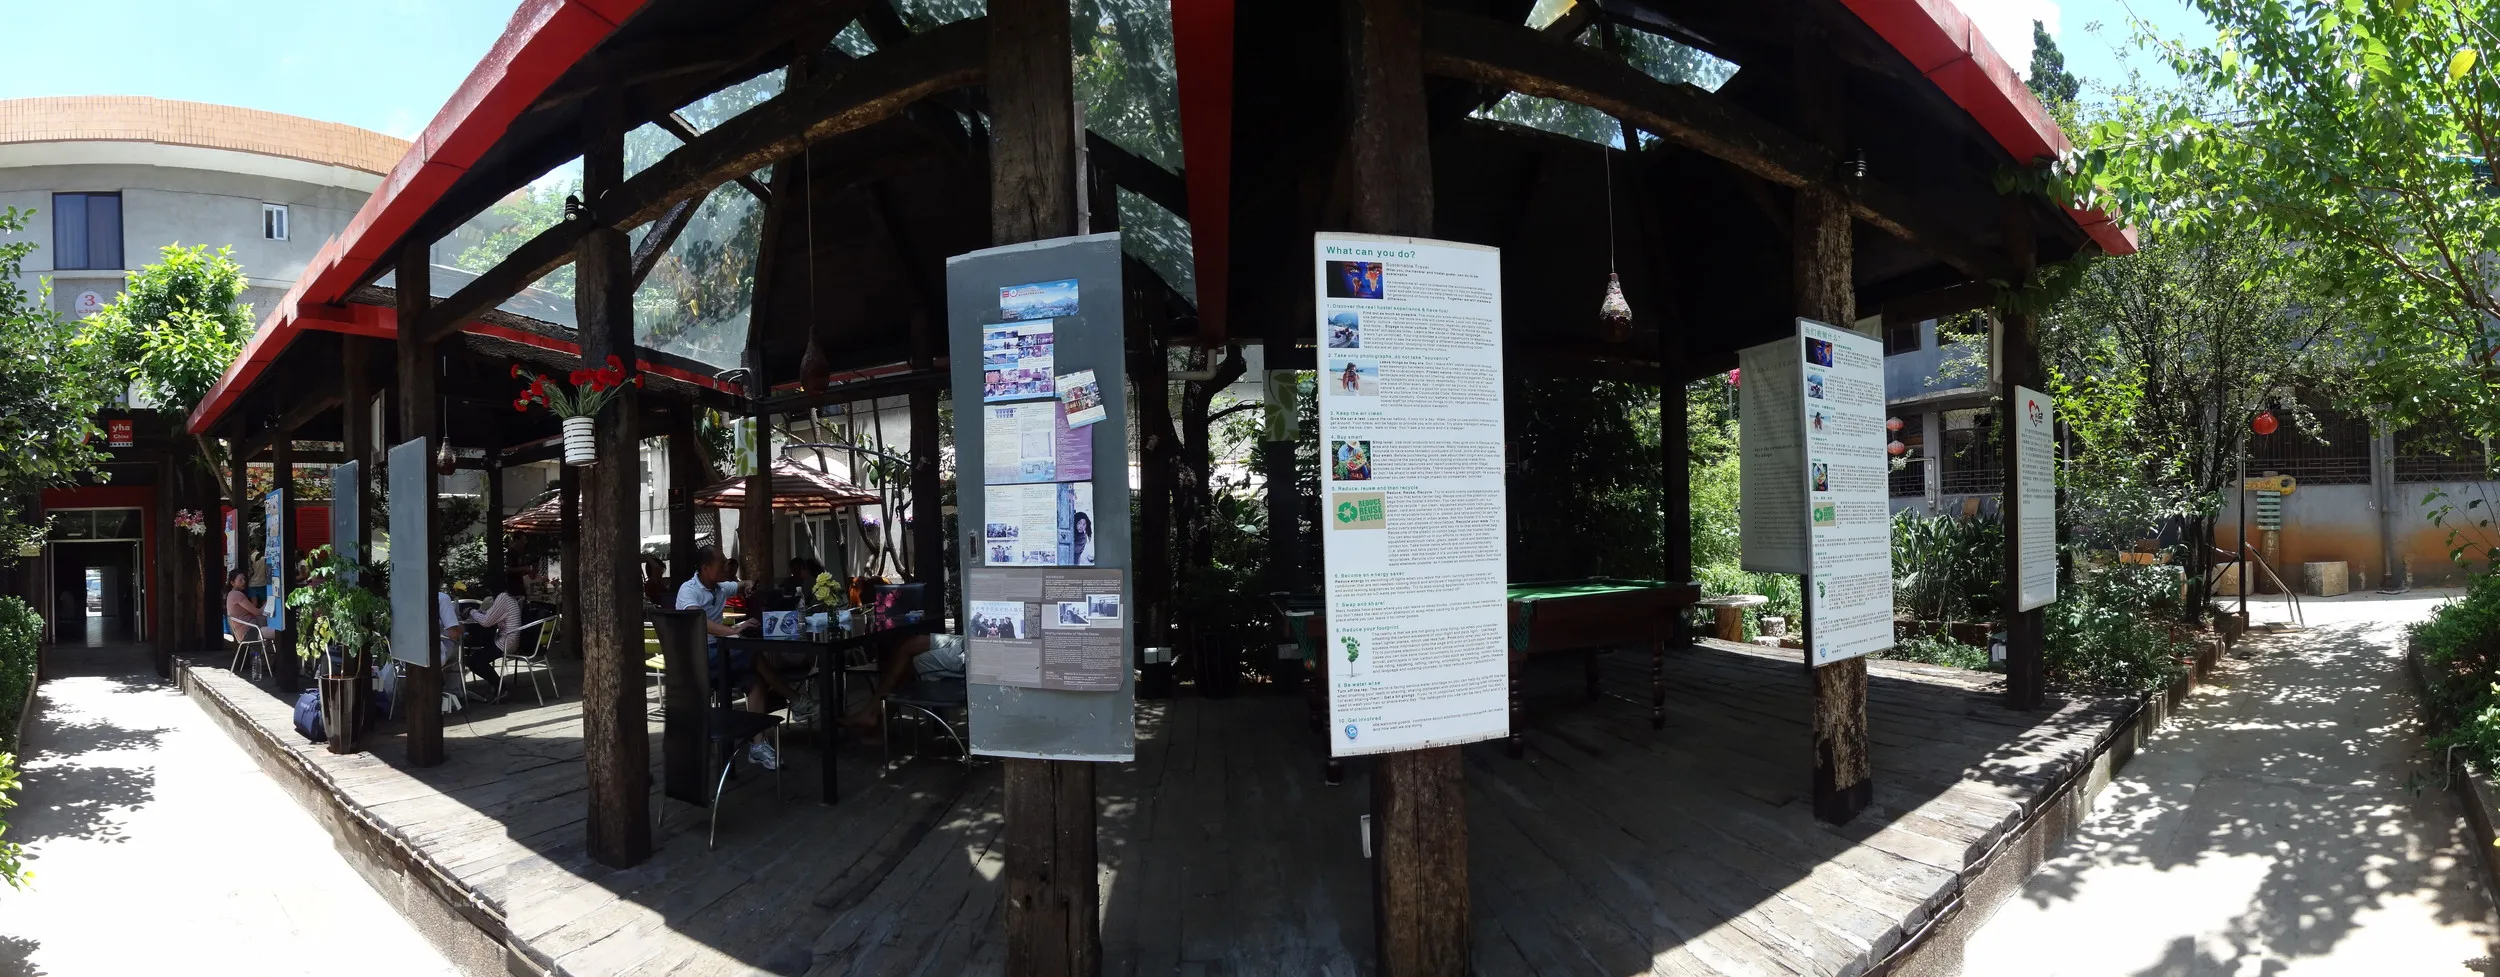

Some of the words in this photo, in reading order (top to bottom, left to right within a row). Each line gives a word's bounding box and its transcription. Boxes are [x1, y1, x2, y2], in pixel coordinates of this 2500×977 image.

[1326, 246, 1353, 255] What
[1377, 250, 1394, 258] you
[1398, 250, 1415, 258] do?
[84, 294, 95, 306] 3
[112, 424, 130, 432] yha
[1358, 498, 1381, 506] REDUCE
[1359, 505, 1382, 516] REUSE
[1360, 513, 1383, 522] RECYCLE
